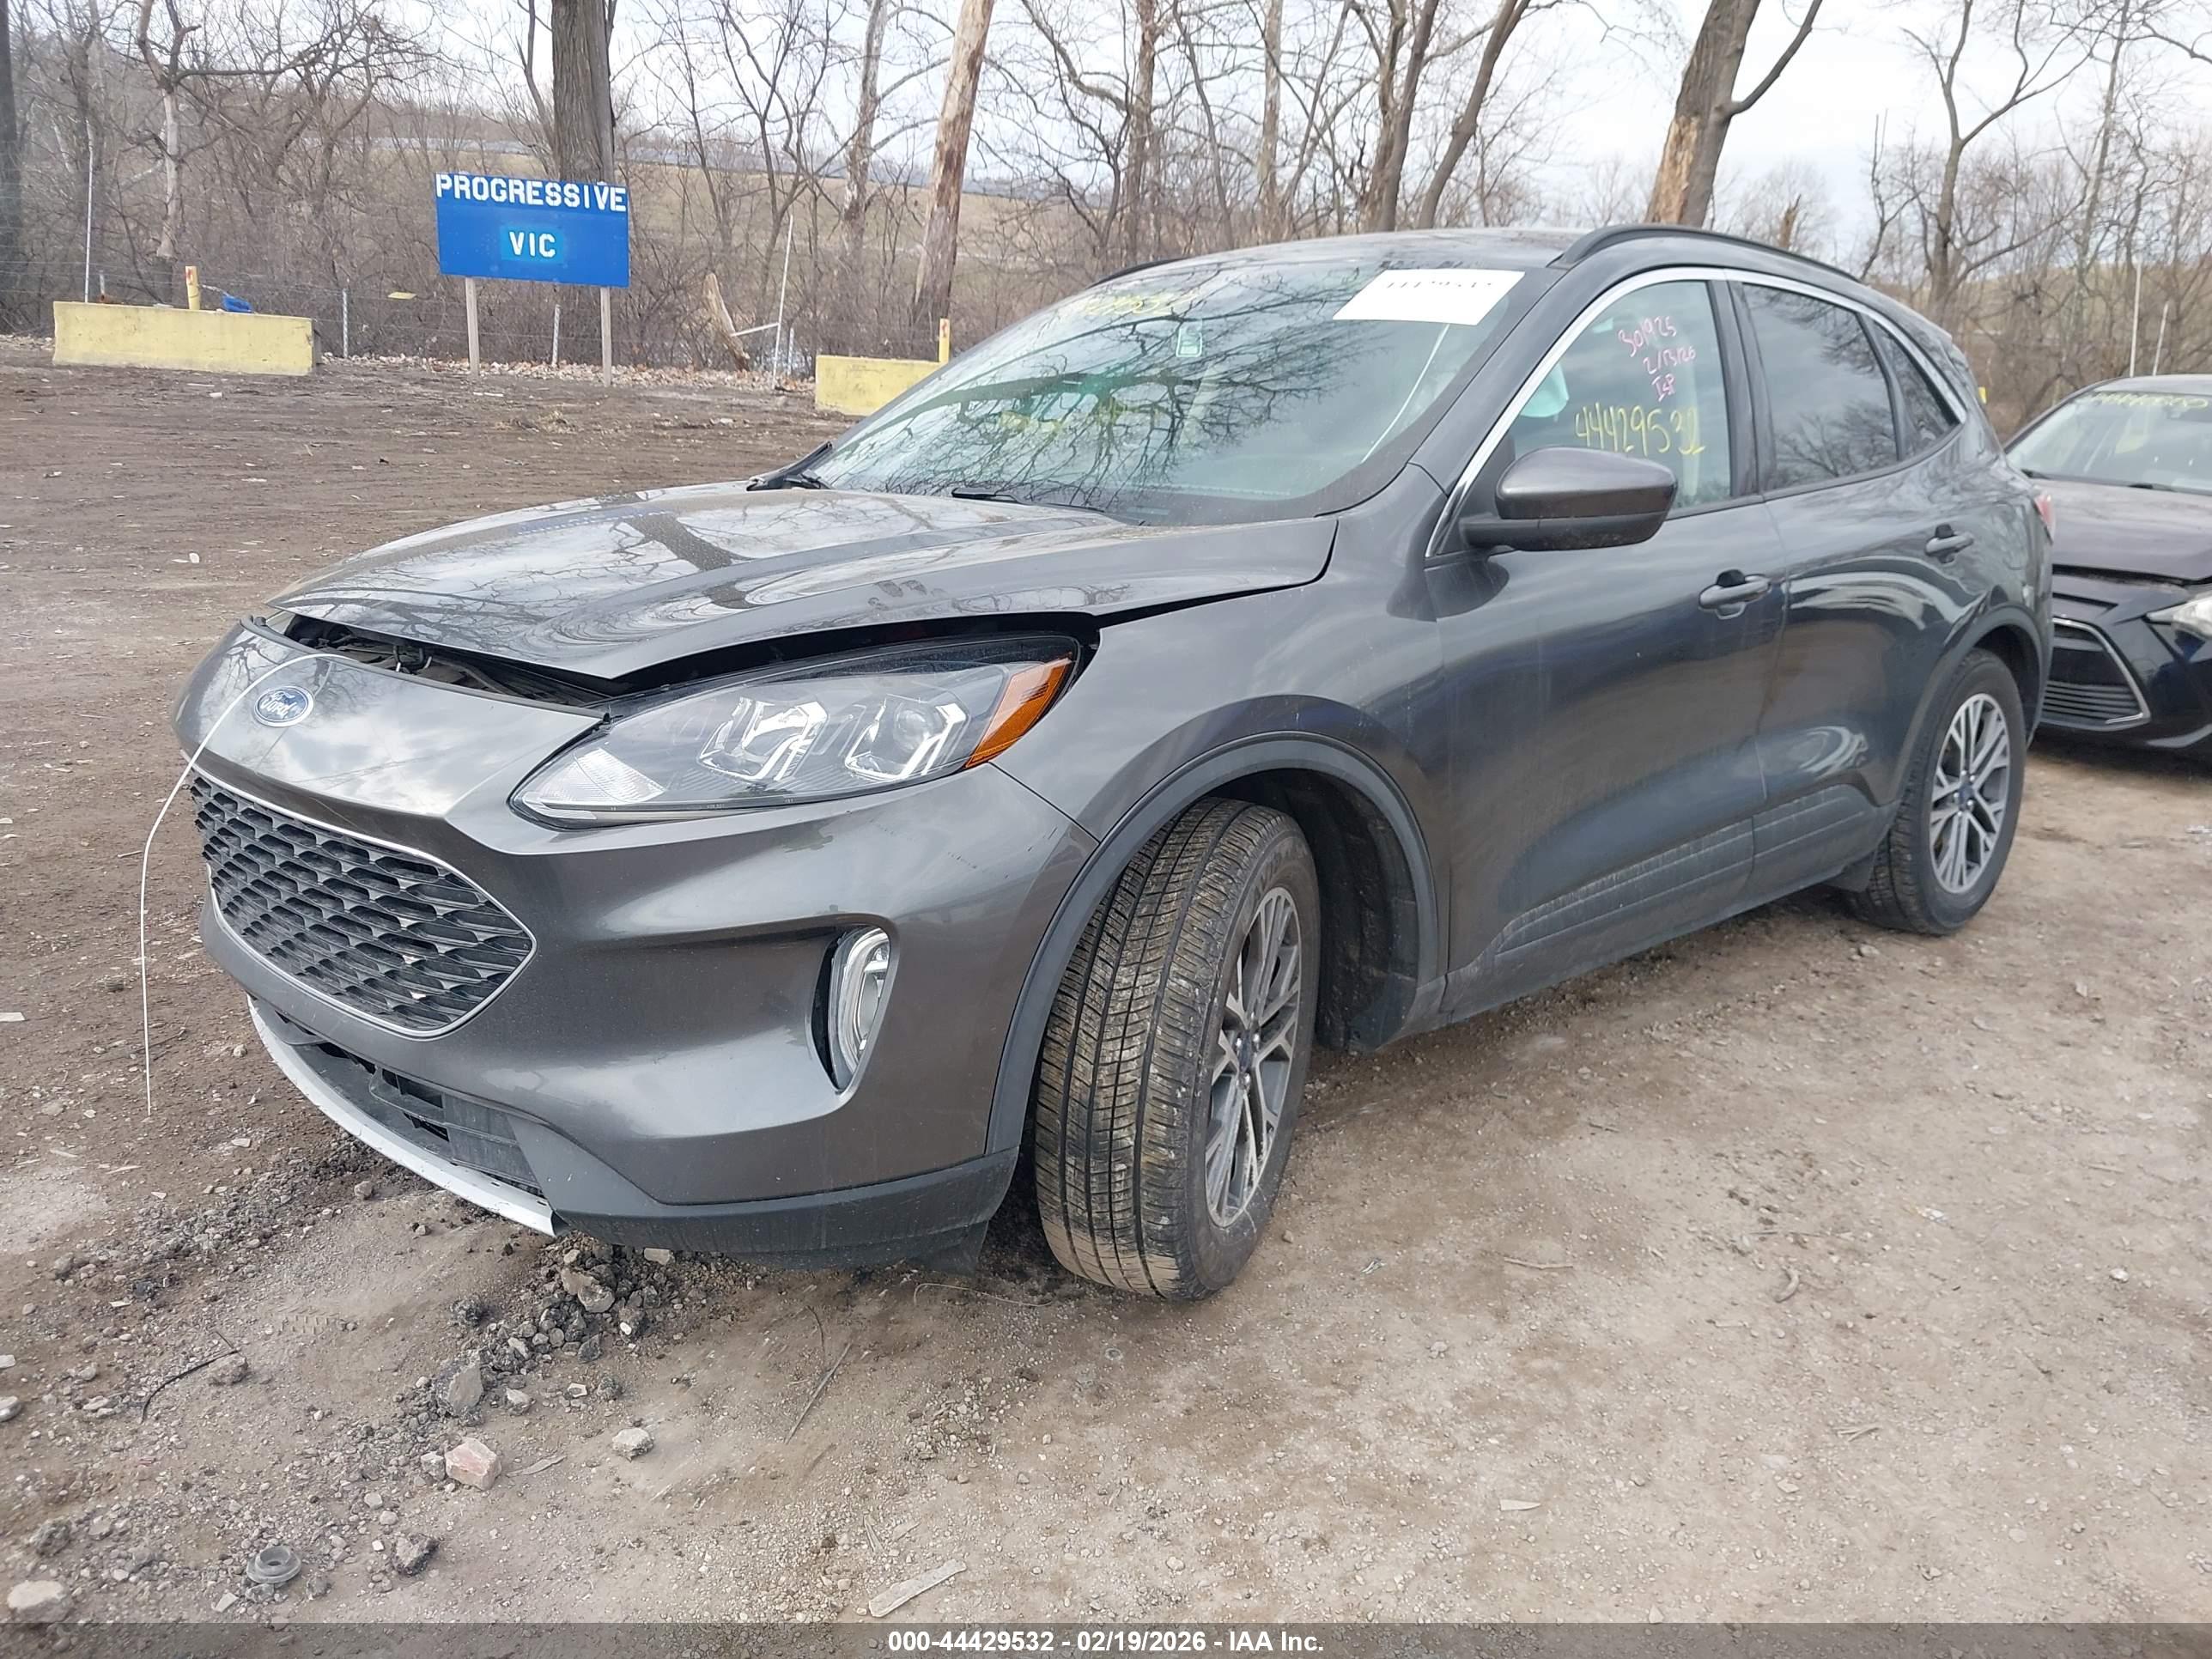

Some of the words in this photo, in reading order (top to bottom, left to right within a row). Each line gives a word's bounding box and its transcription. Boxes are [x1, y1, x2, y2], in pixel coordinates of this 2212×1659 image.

[435, 173, 627, 211] PROGRESSIVE
[508, 230, 556, 258] VIC
[260, 690, 298, 720] Ford
